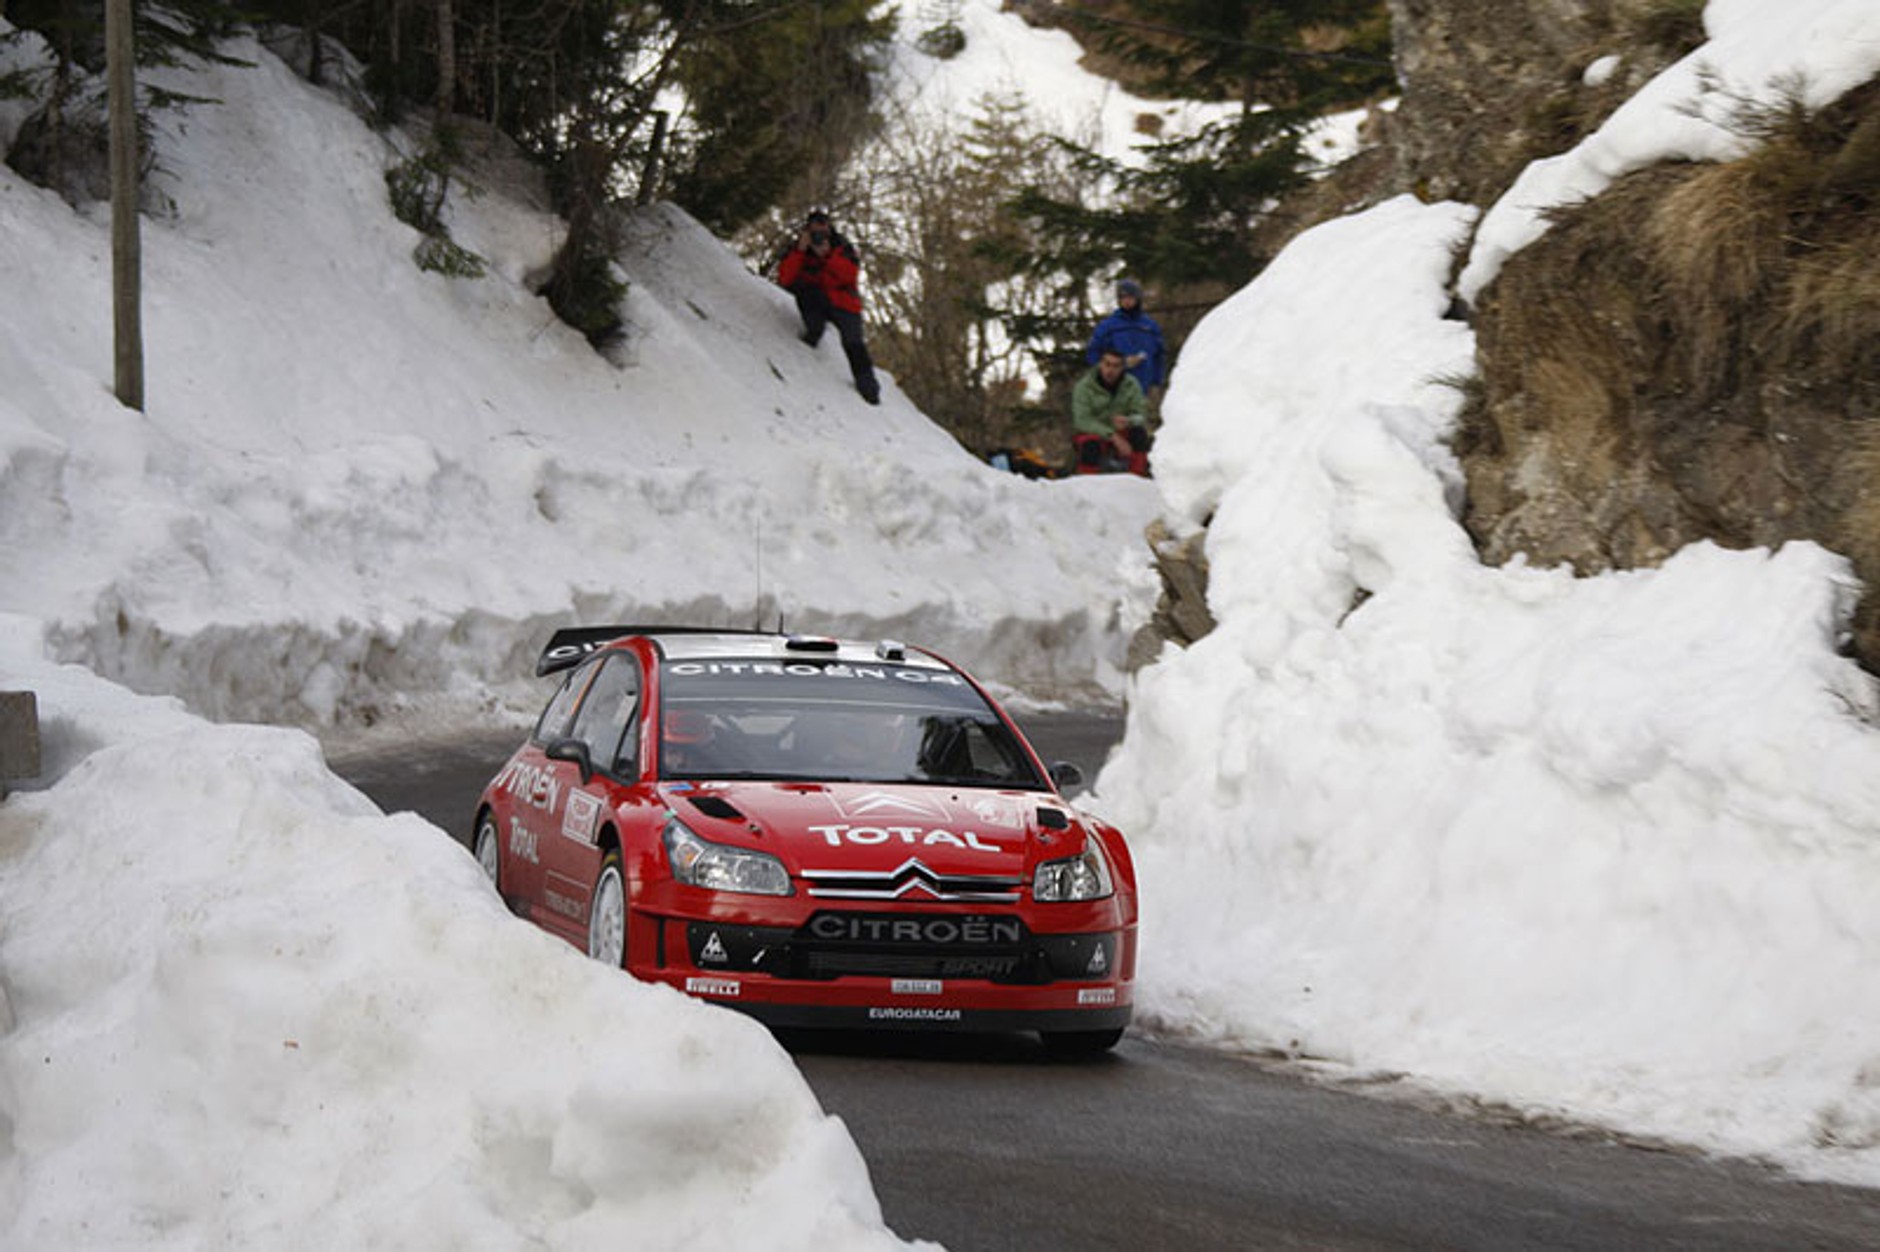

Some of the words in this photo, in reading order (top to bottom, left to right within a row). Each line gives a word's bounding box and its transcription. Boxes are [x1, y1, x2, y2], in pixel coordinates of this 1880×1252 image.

[669, 663, 886, 679] CITROËN
[895, 670, 963, 686] C4
[510, 816, 540, 865] TOTAL
[808, 824, 1002, 853] TOTAL
[810, 915, 1020, 942] CITROËN
